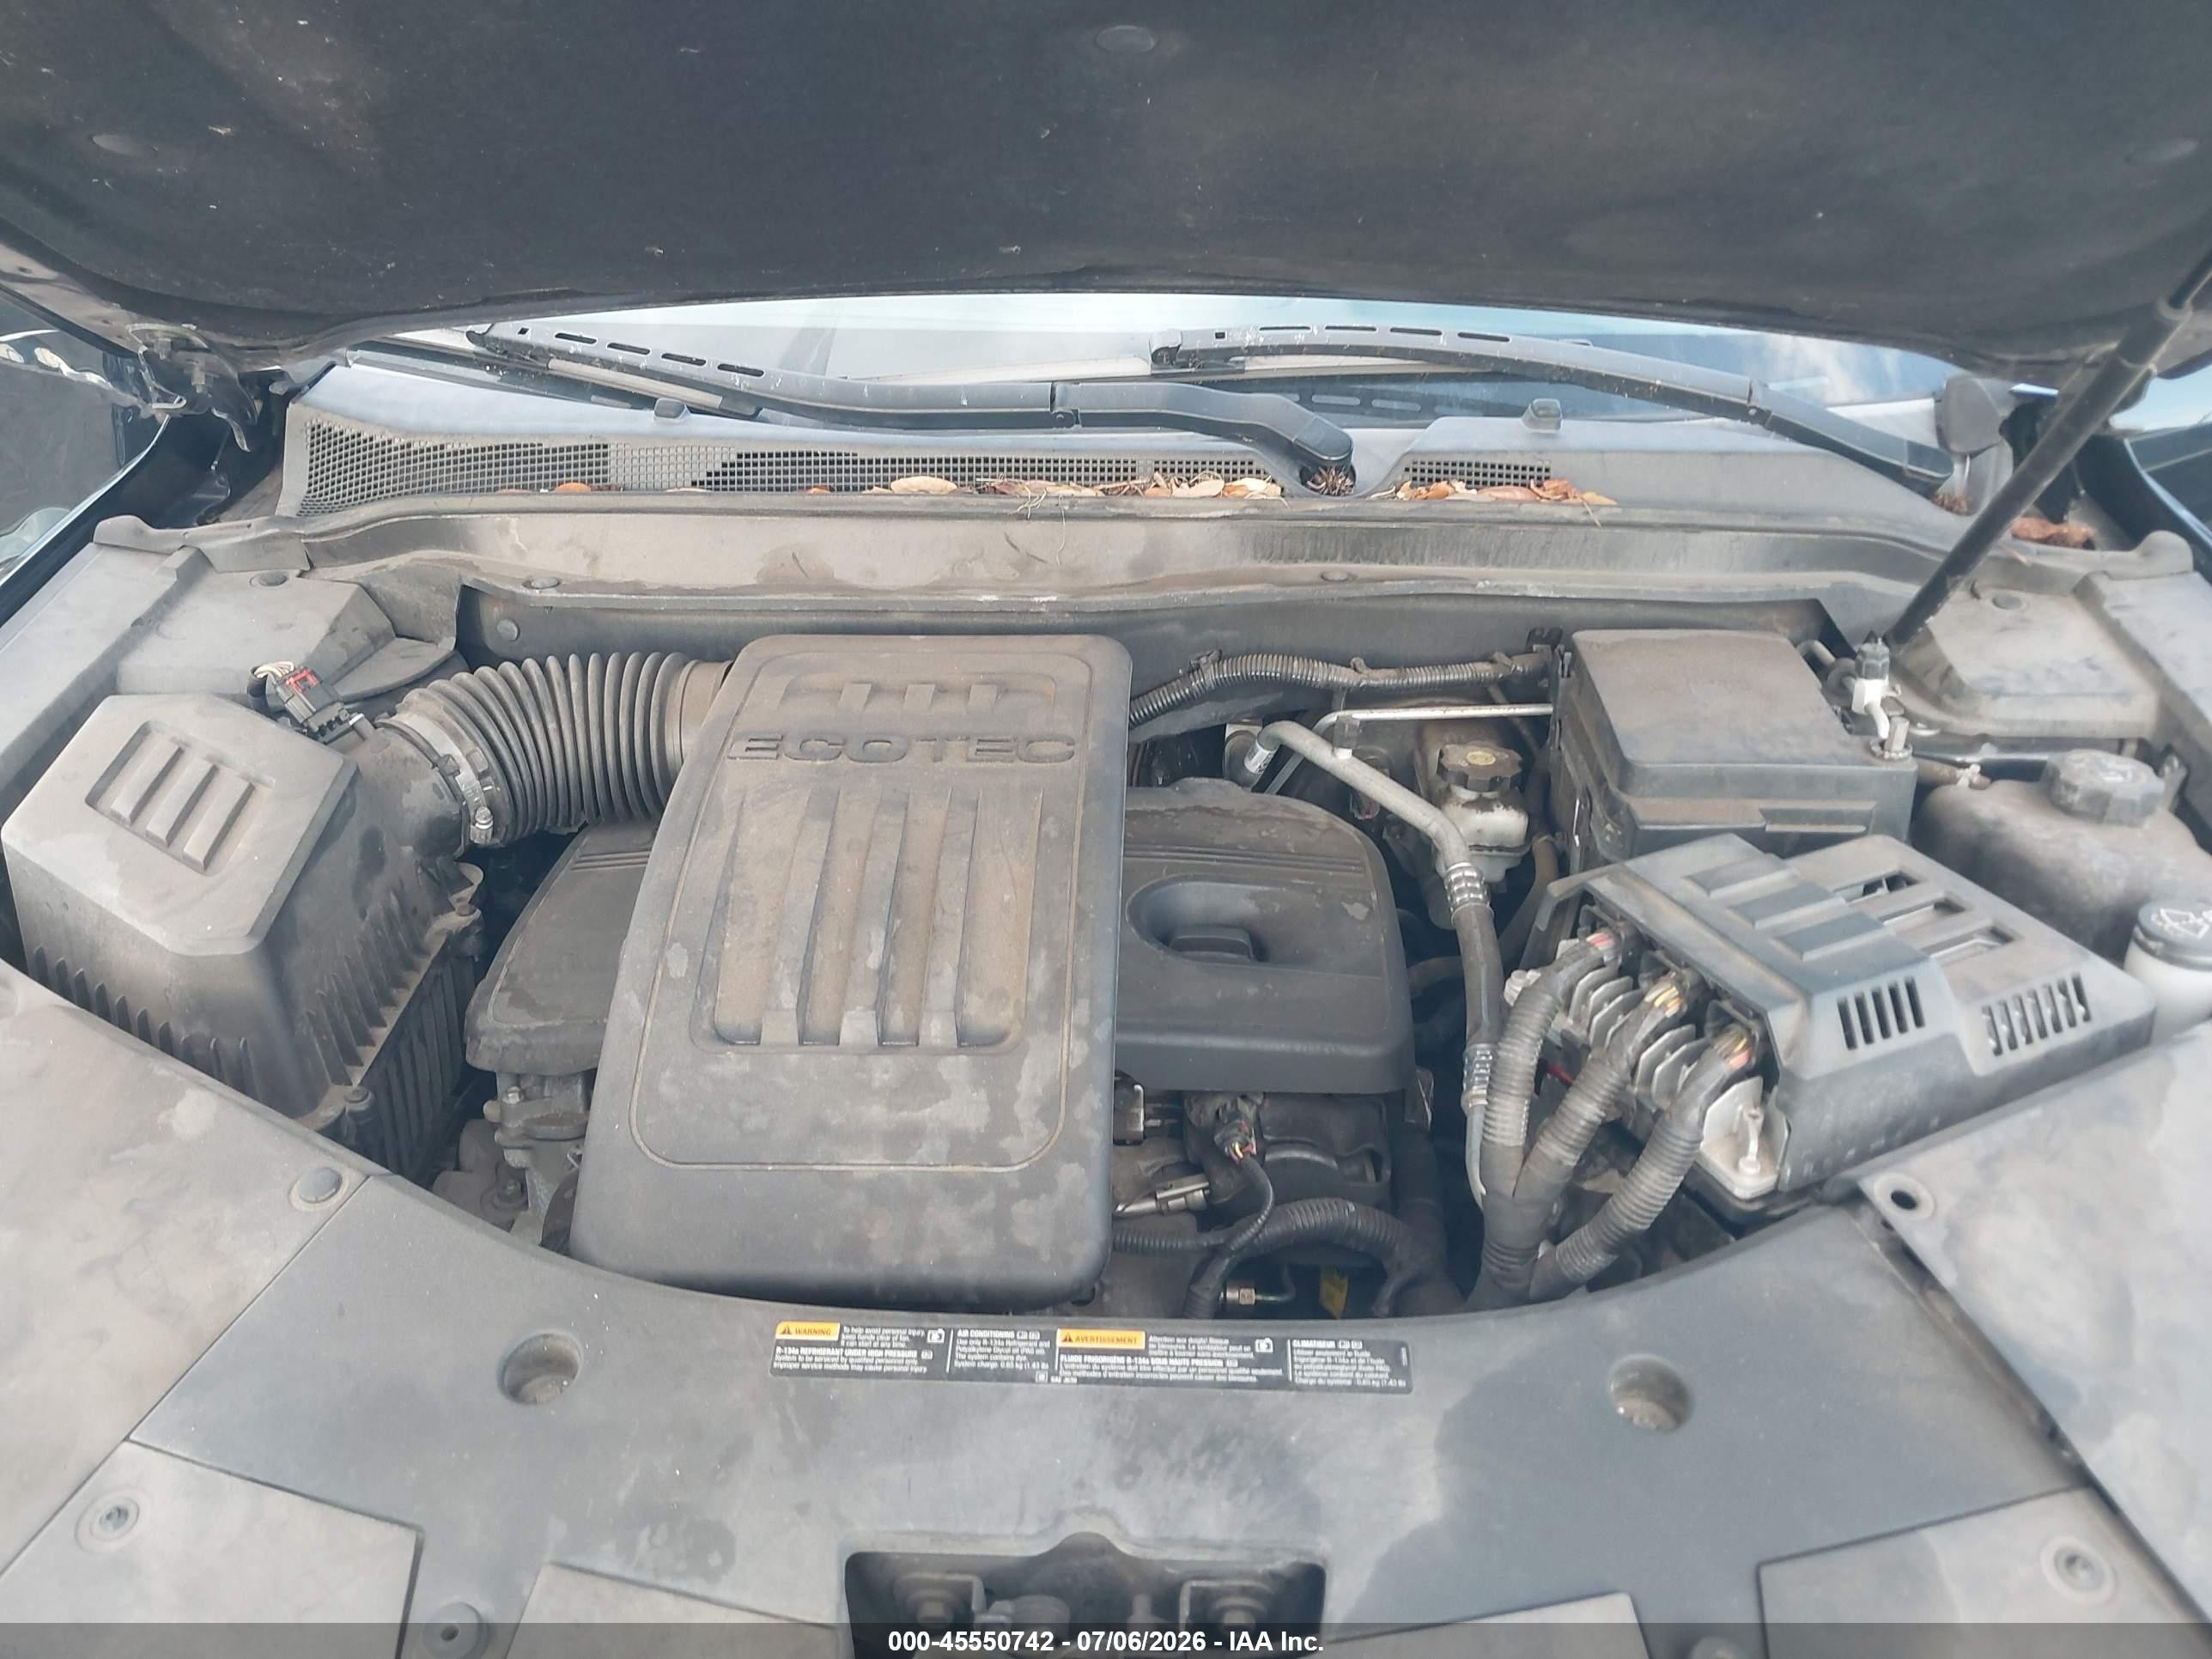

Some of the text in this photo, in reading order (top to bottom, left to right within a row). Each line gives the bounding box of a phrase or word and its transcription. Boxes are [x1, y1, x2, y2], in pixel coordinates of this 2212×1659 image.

[727, 734, 1075, 763] ECOTEC
[795, 1328, 830, 1336] WARNING
[970, 1329, 1014, 1338] CONDITIONING
[1076, 1334, 1137, 1344] AVERTISSEMENT
[800, 1347, 844, 1356] REFRIGERANT
[845, 1348, 866, 1357] UNDER
[867, 1348, 883, 1358] HIGH
[884, 1349, 917, 1358] PRESSURE
